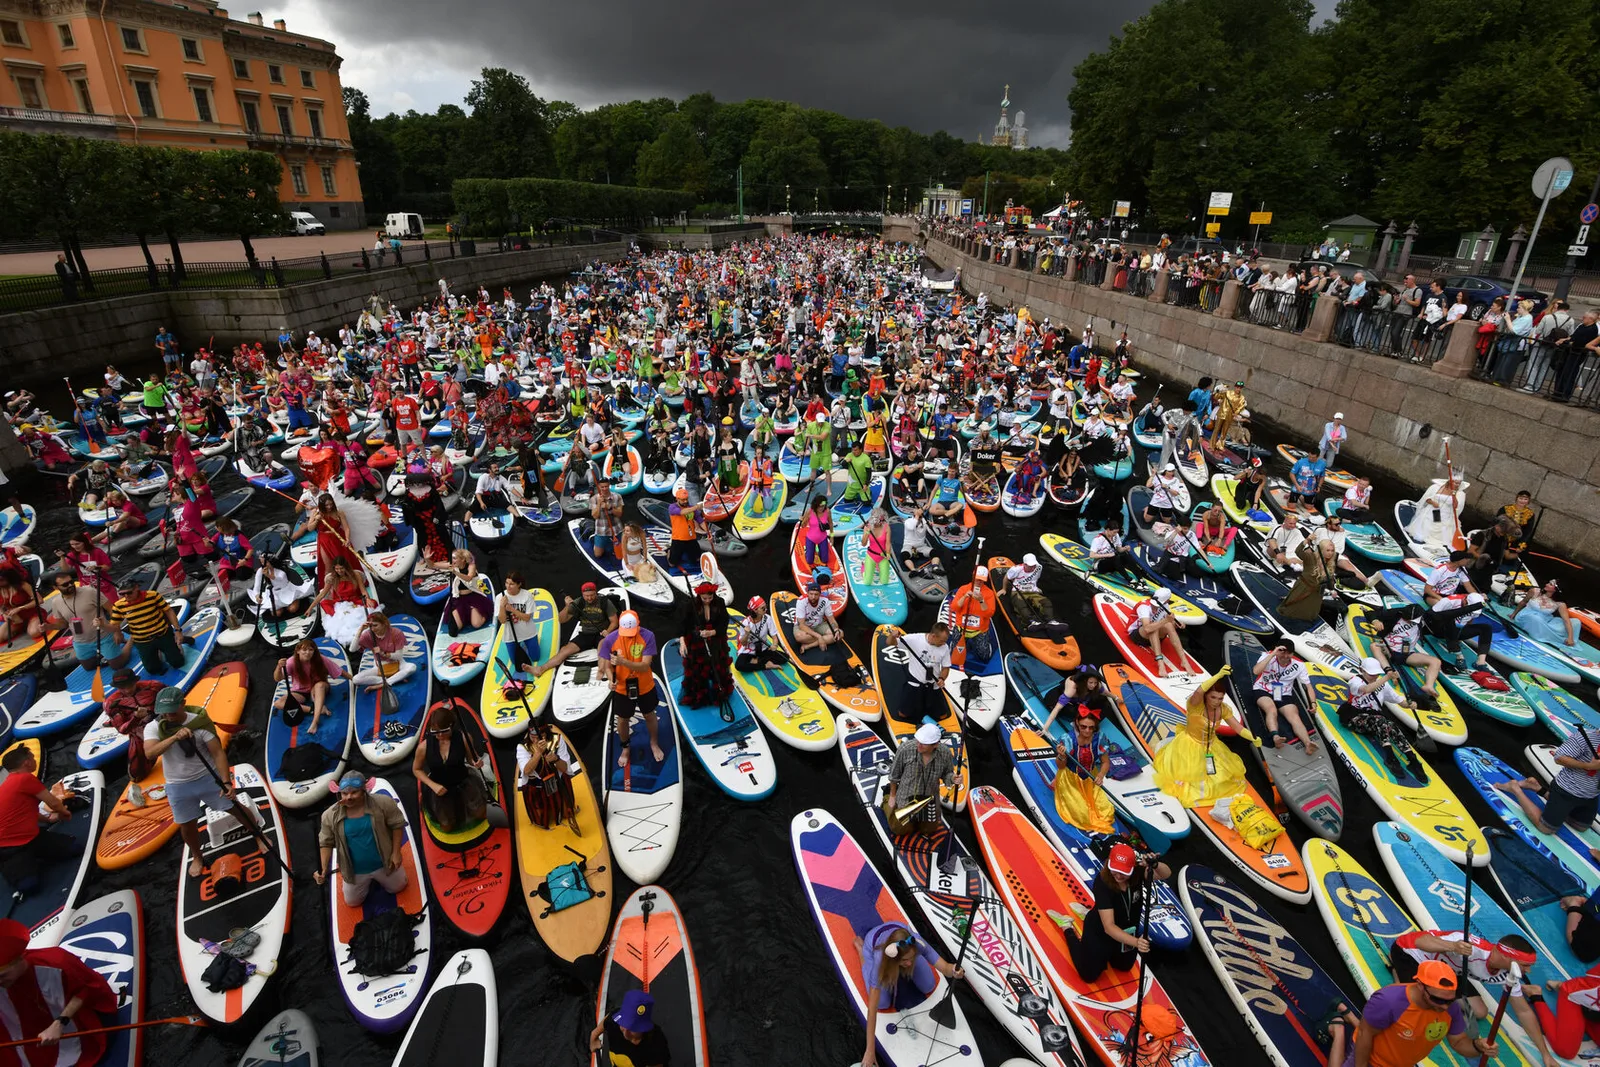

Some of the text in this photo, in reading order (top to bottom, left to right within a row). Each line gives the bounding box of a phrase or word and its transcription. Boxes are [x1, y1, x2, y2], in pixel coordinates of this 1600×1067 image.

[977, 452, 996, 460] Doker
[1017, 750, 1055, 758] PREMUM
[1340, 752, 1368, 789] BOARD
[452, 879, 502, 899] HikenWater
[938, 870, 958, 894] ker
[971, 920, 1011, 967] Doker
[1350, 963, 1369, 993] BOARD
[381, 990, 405, 1003] 03086
